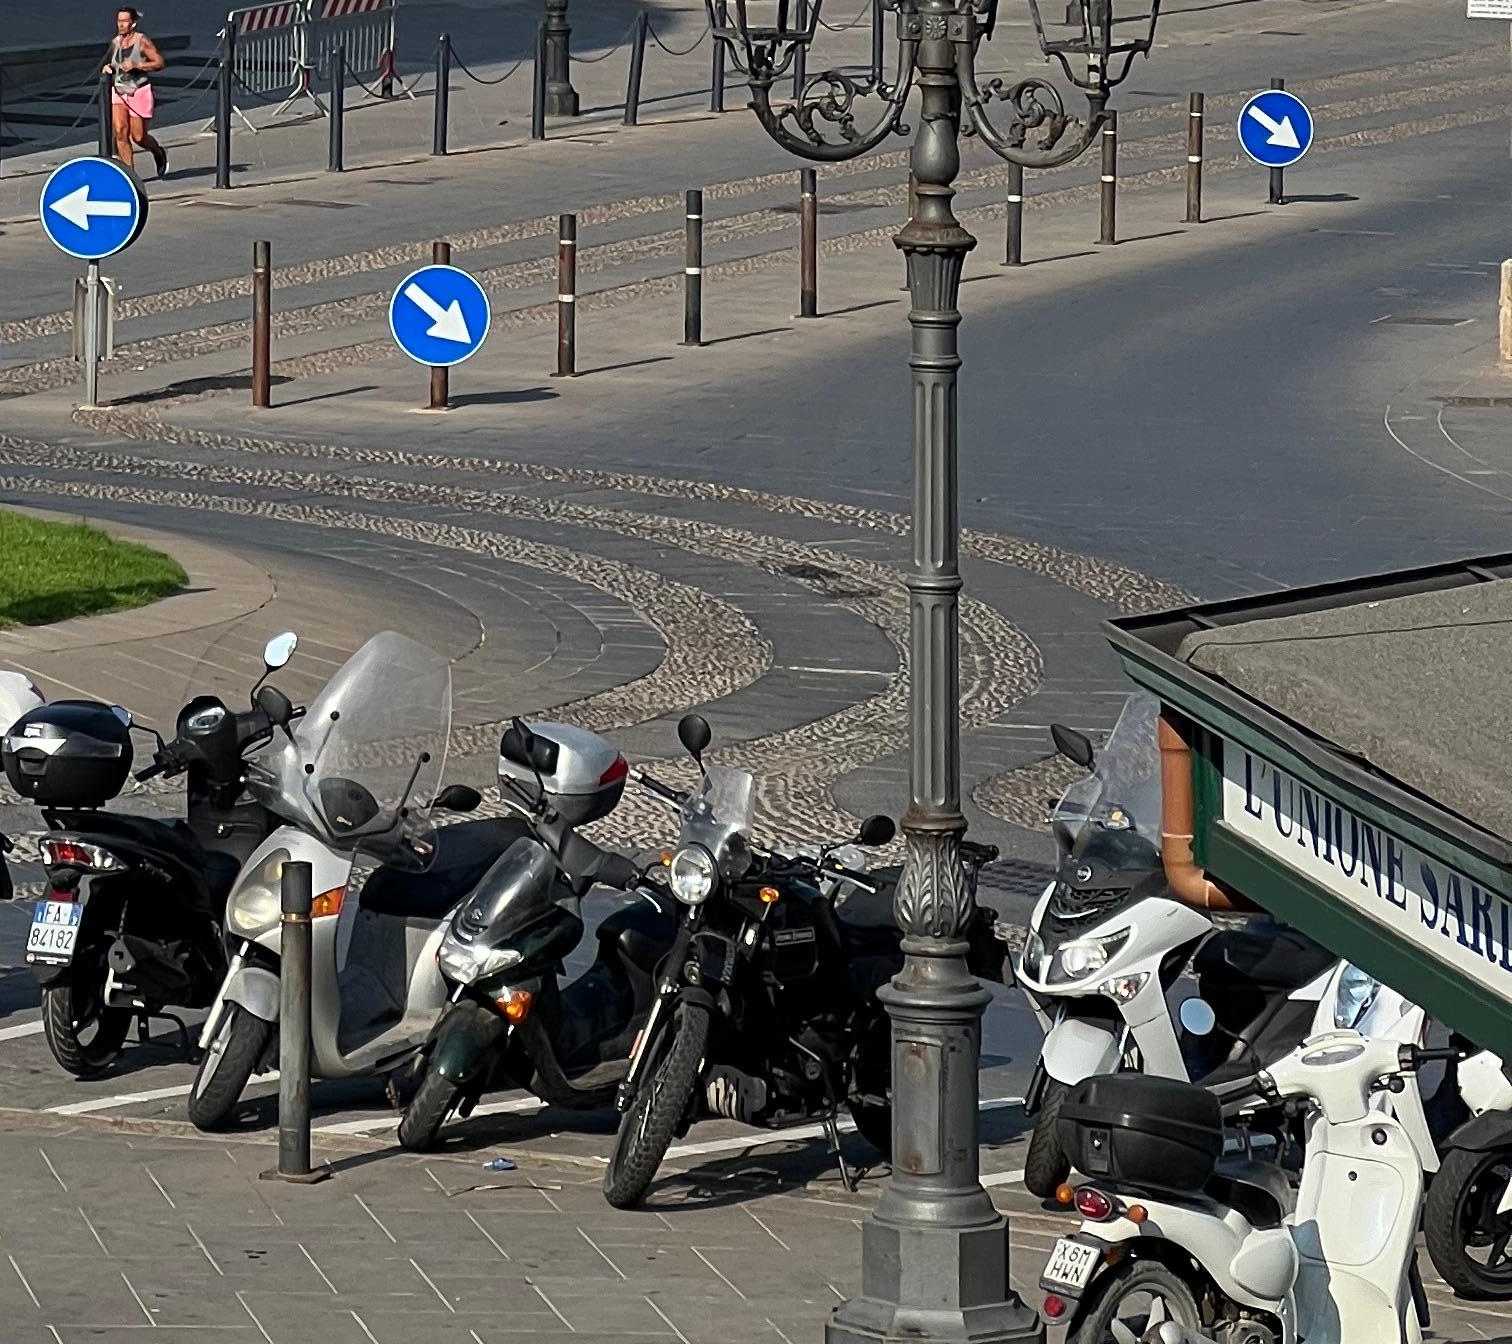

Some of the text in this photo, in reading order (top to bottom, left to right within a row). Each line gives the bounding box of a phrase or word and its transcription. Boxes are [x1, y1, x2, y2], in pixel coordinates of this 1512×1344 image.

[1244, 752, 1407, 911] L'UNIONE
[30, 927, 74, 950] 84182
[1049, 1261, 1085, 1283] HWN
